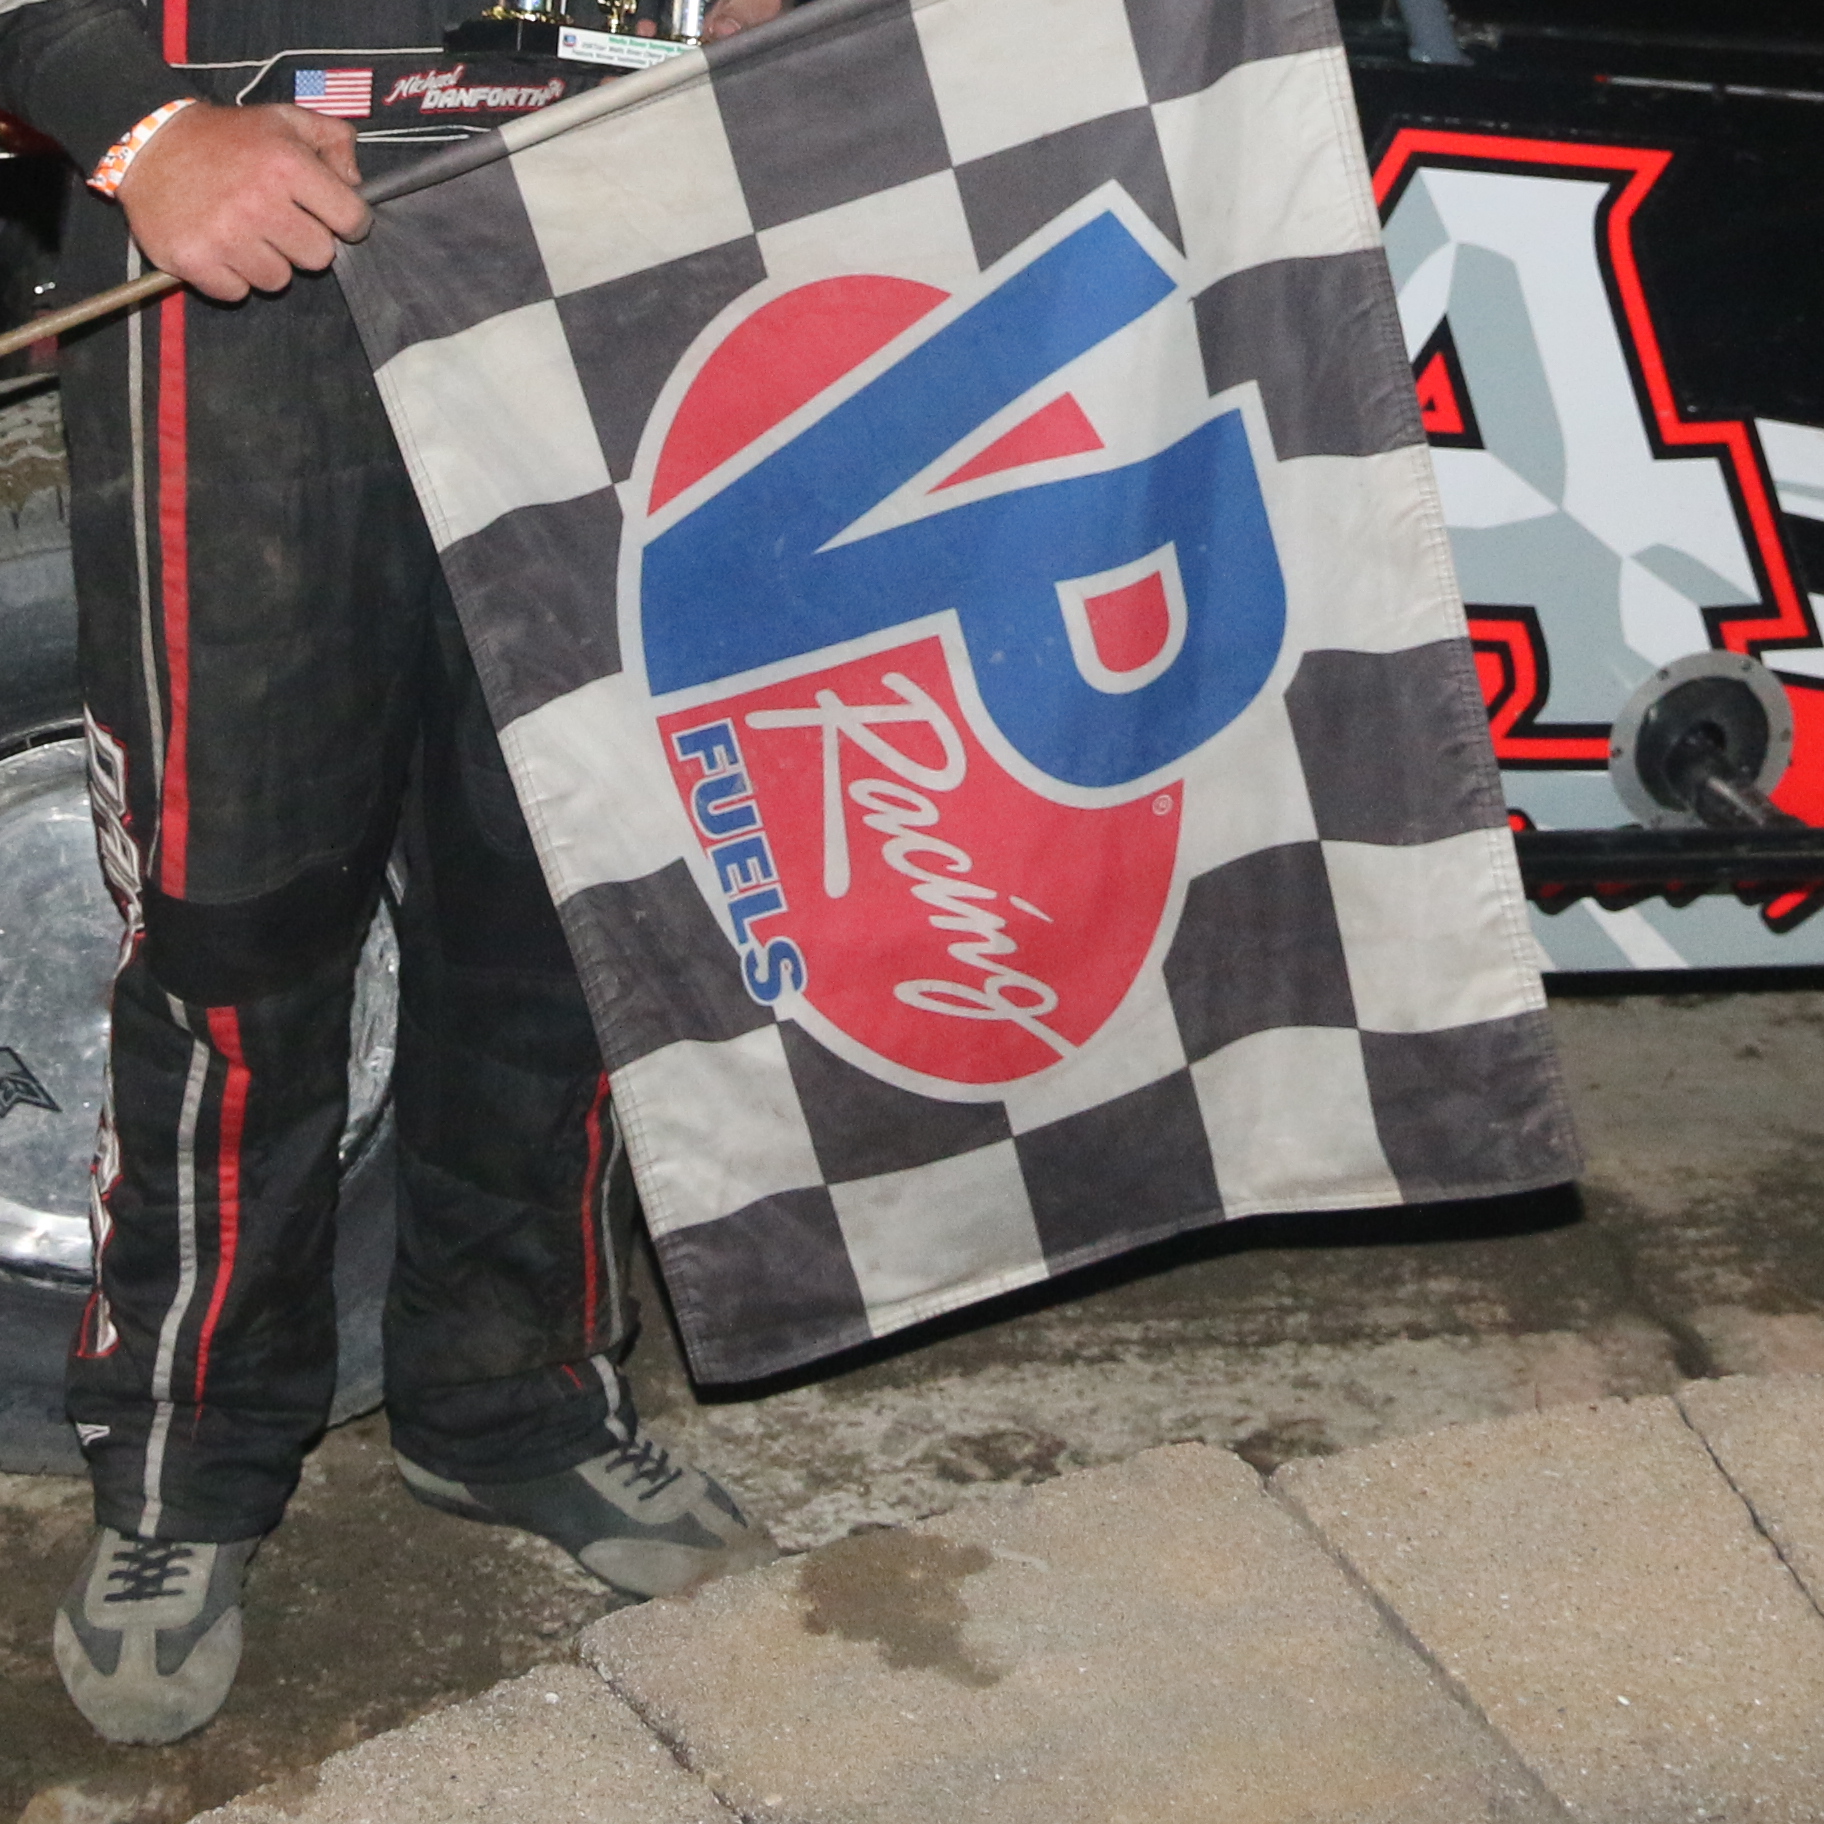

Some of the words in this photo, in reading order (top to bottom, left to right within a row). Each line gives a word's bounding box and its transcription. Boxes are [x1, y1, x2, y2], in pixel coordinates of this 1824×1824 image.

[421, 86, 550, 110] DANFORTH
[639, 207, 1288, 788] VP
[674, 716, 809, 1008] FUELS
[743, 670, 1081, 1062] Racing
